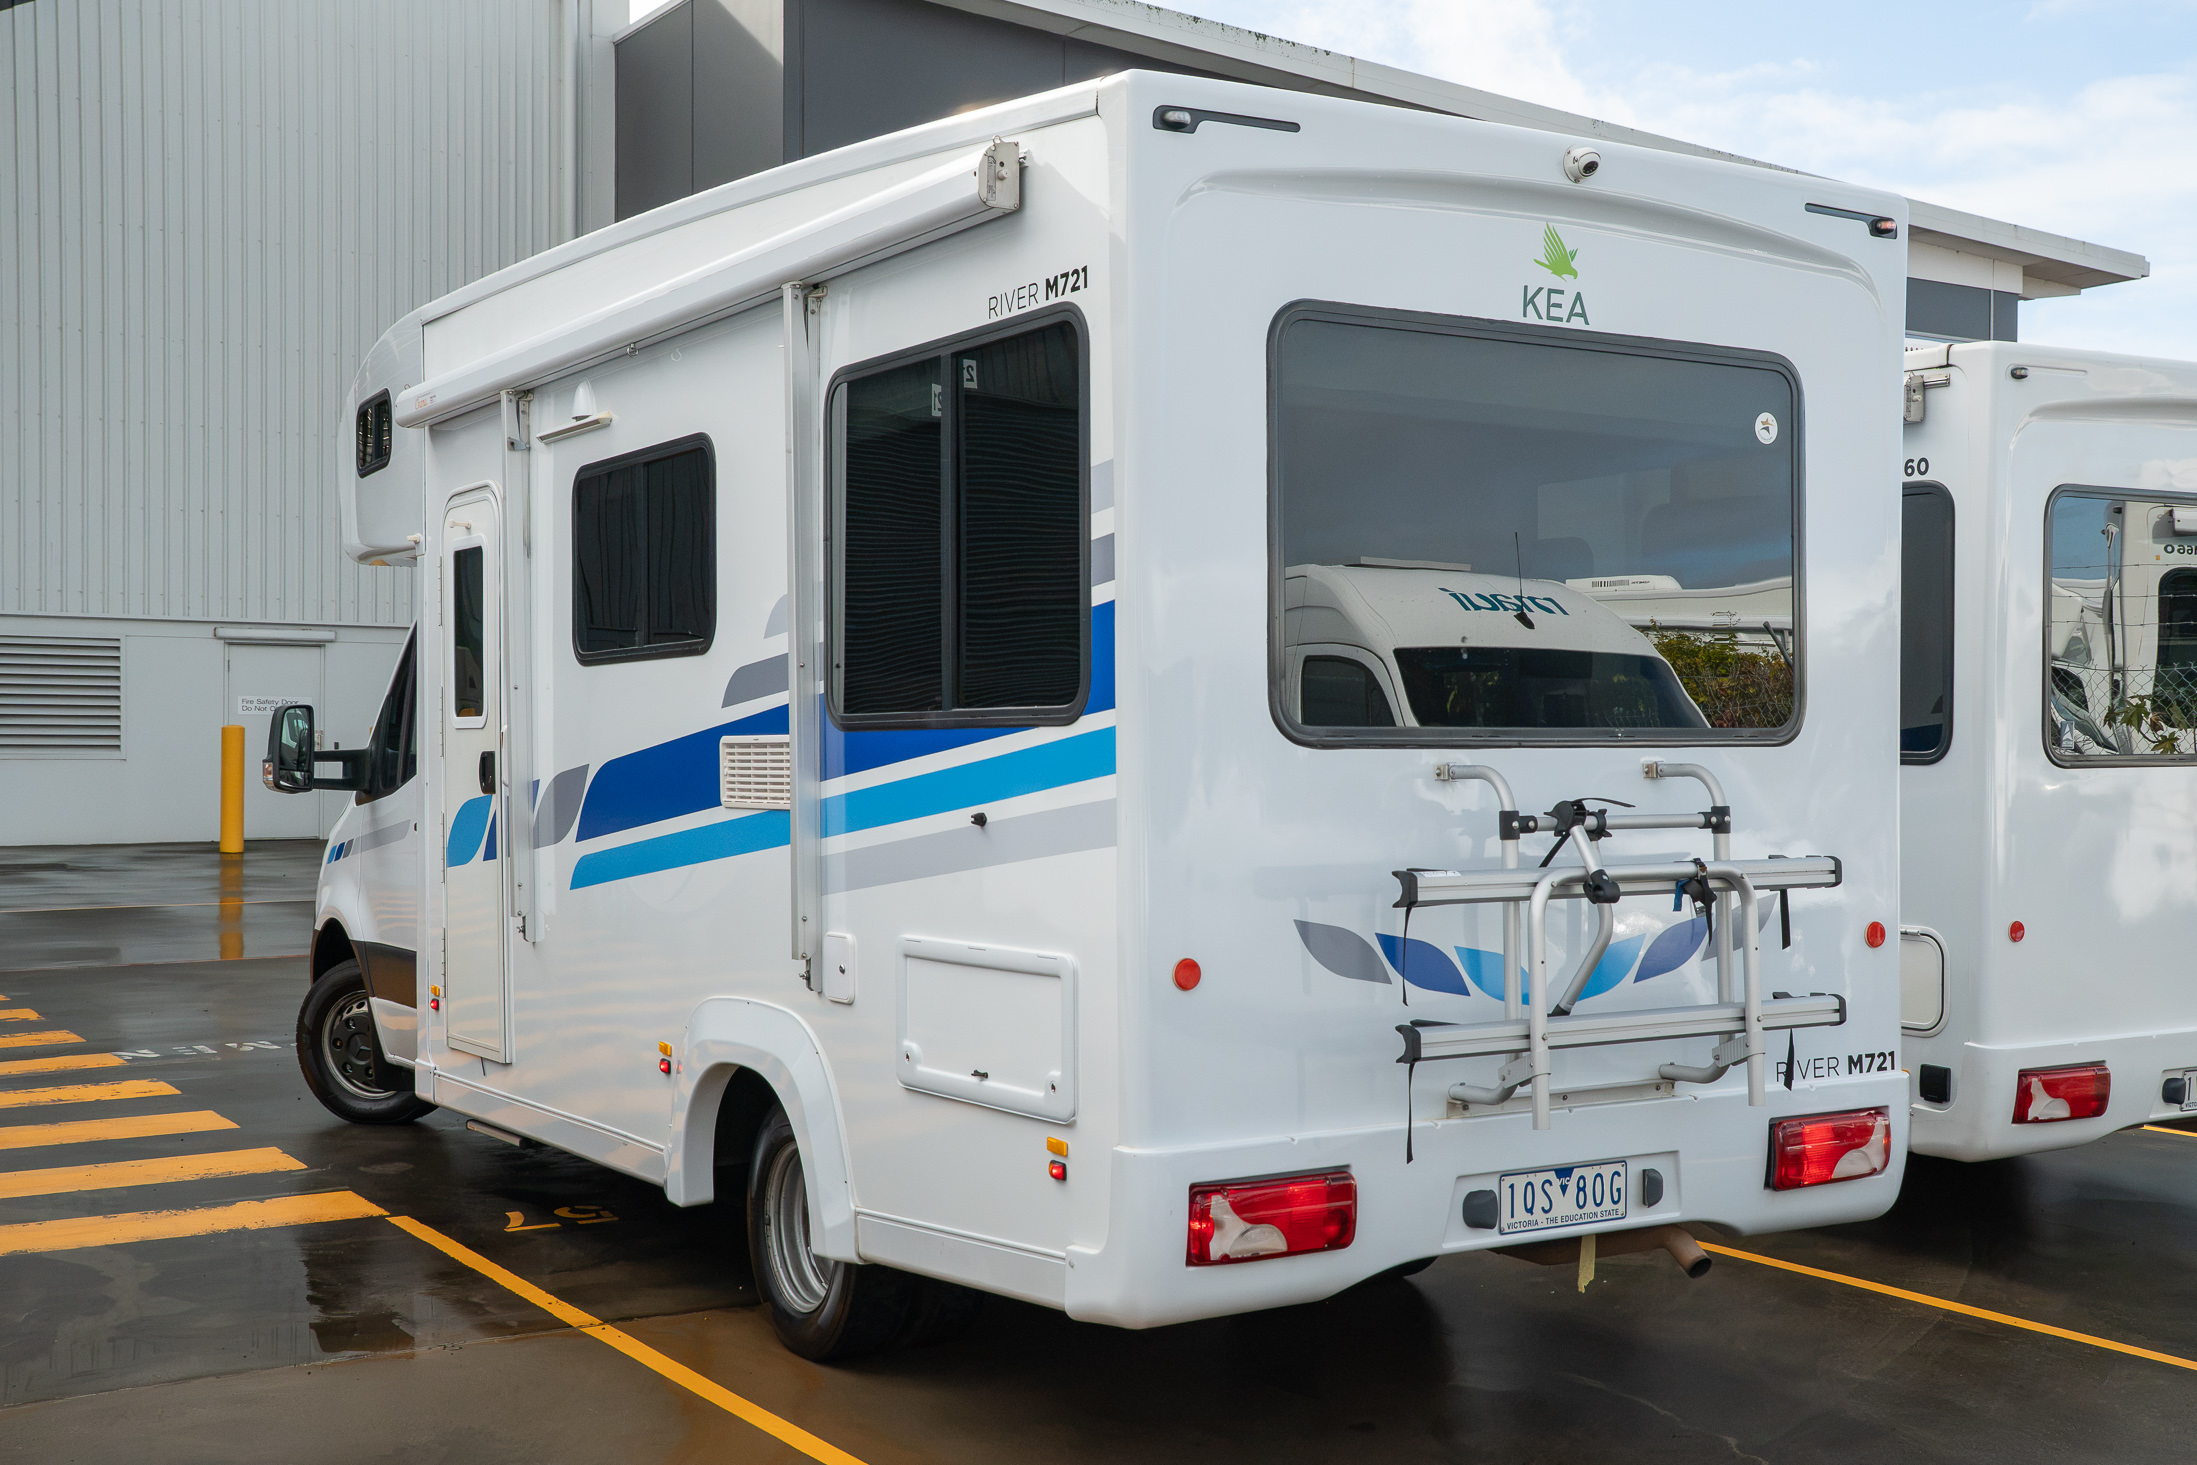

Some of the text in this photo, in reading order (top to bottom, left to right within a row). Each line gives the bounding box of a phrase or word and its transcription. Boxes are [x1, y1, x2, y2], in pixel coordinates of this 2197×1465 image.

[988, 264, 1088, 320] RIVER M721
[1522, 284, 1590, 326] KEA
[256, 698, 280, 706] Safety
[1775, 1050, 1895, 1083] RVER M721
[1508, 1178, 1553, 1219] 1QS
[1506, 1218, 1539, 1230] VICTORIA
[1545, 1216, 1559, 1226] THE
[1560, 1210, 1598, 1223] EDUCATION
[1600, 1208, 1620, 1218] STATE
